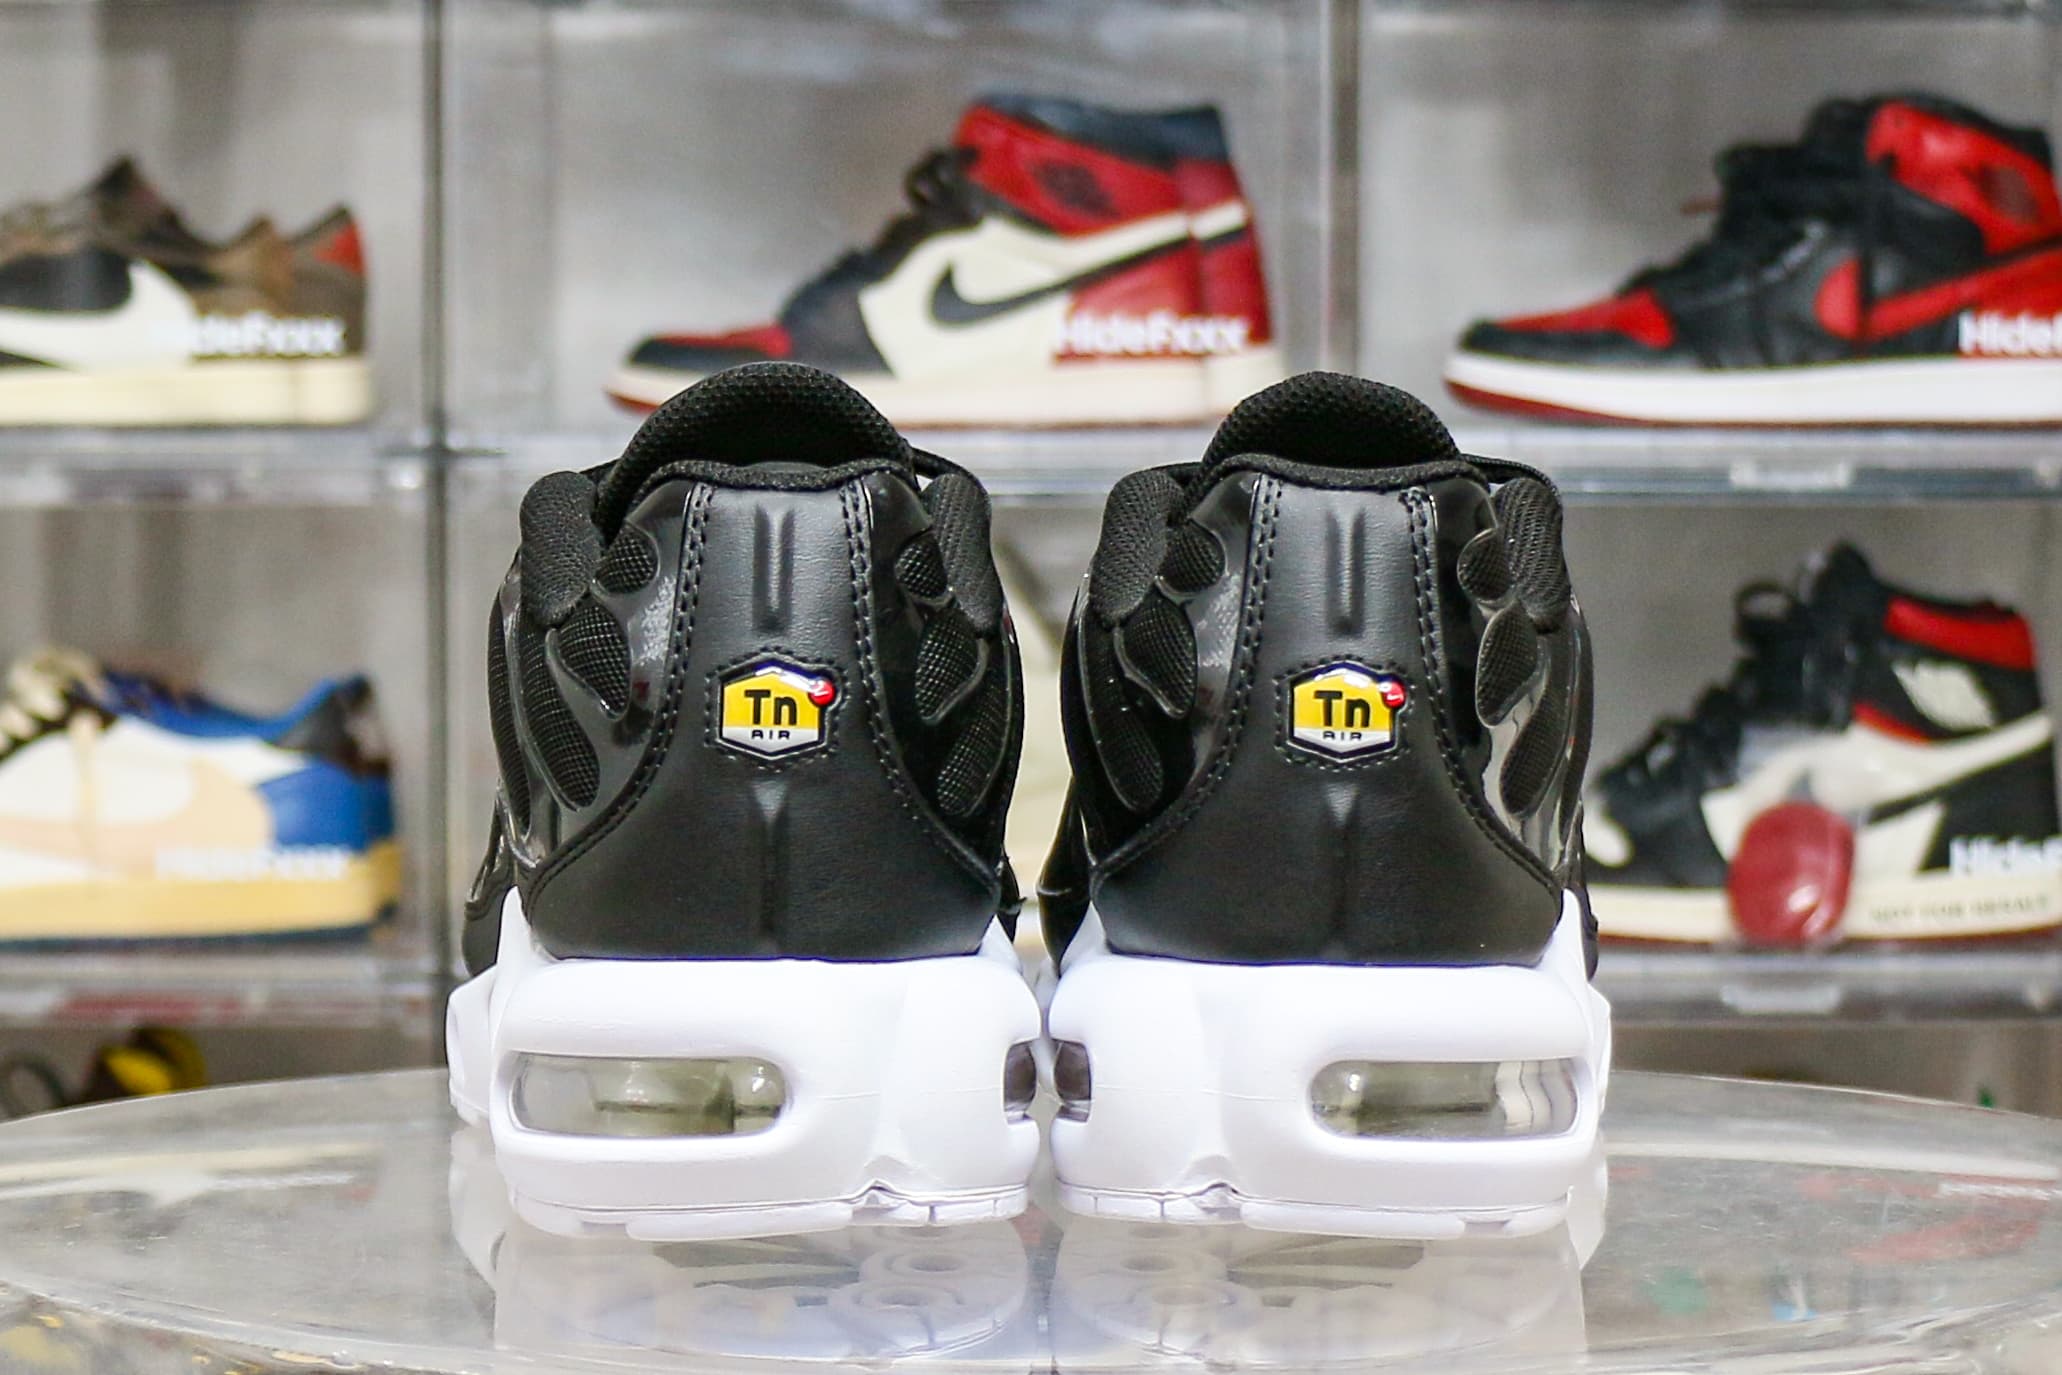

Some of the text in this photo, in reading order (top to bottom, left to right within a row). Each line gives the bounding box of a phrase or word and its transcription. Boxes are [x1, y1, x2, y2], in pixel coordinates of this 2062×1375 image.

[1056, 309, 1248, 353] HideFxxx
[745, 689, 798, 725] Tn
[1314, 690, 1370, 728] Tn
[751, 729, 790, 739] AIR
[1323, 731, 1362, 741] AIR
